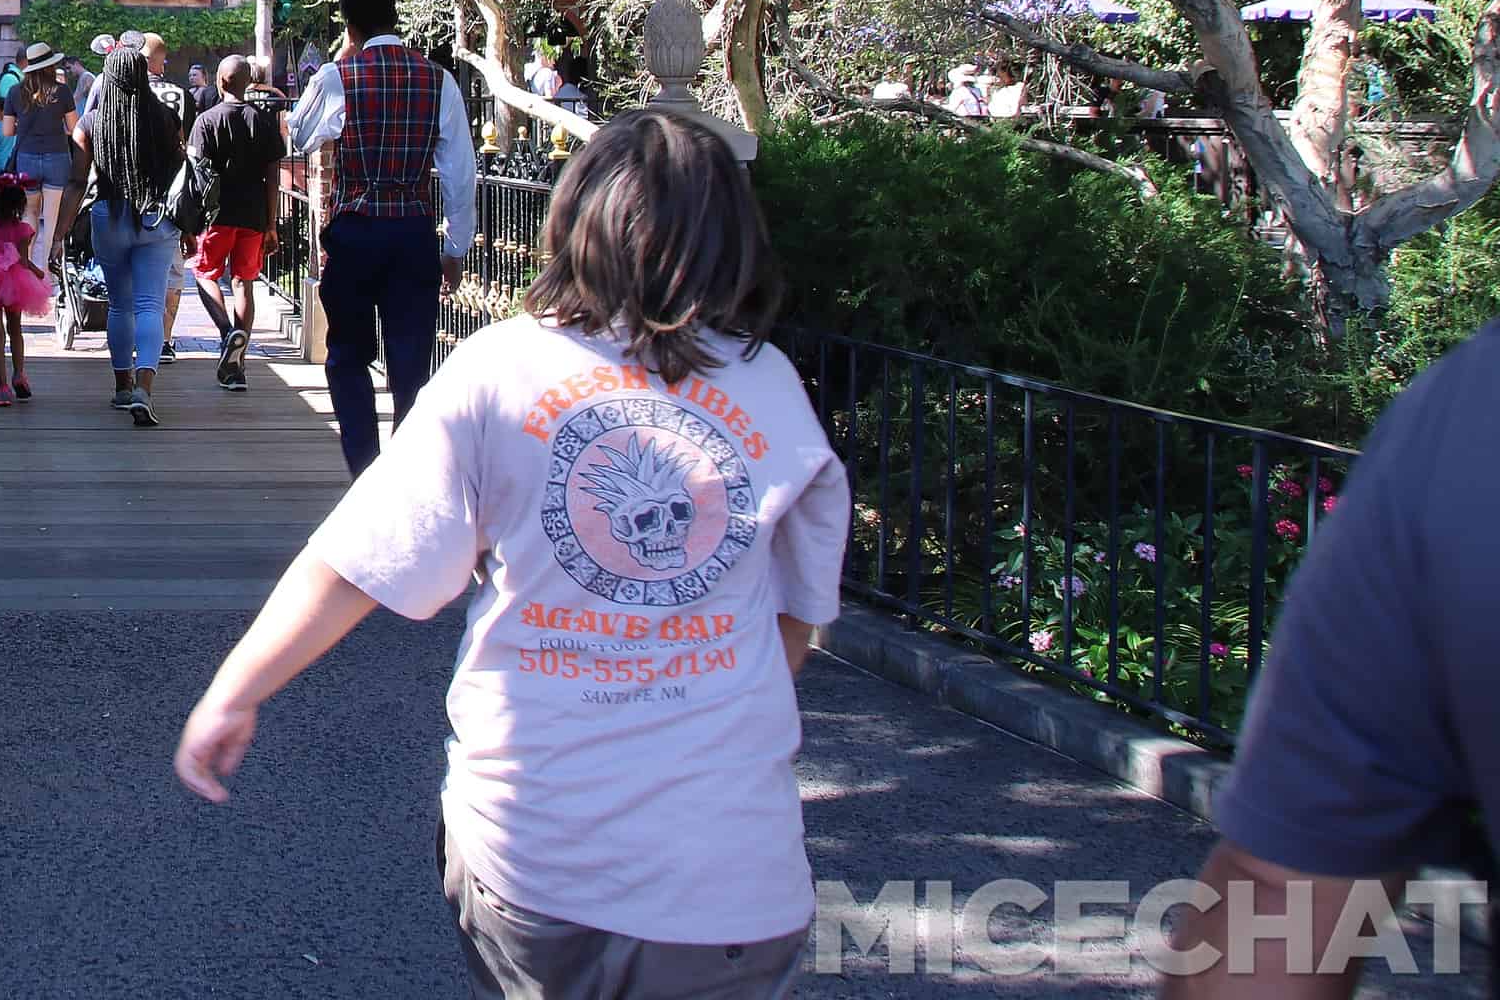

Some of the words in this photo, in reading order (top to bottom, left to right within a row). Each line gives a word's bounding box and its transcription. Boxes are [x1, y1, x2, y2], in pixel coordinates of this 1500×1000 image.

[523, 364, 649, 444] FRESH
[520, 601, 650, 640] AGAVE
[659, 614, 735, 641] BAR
